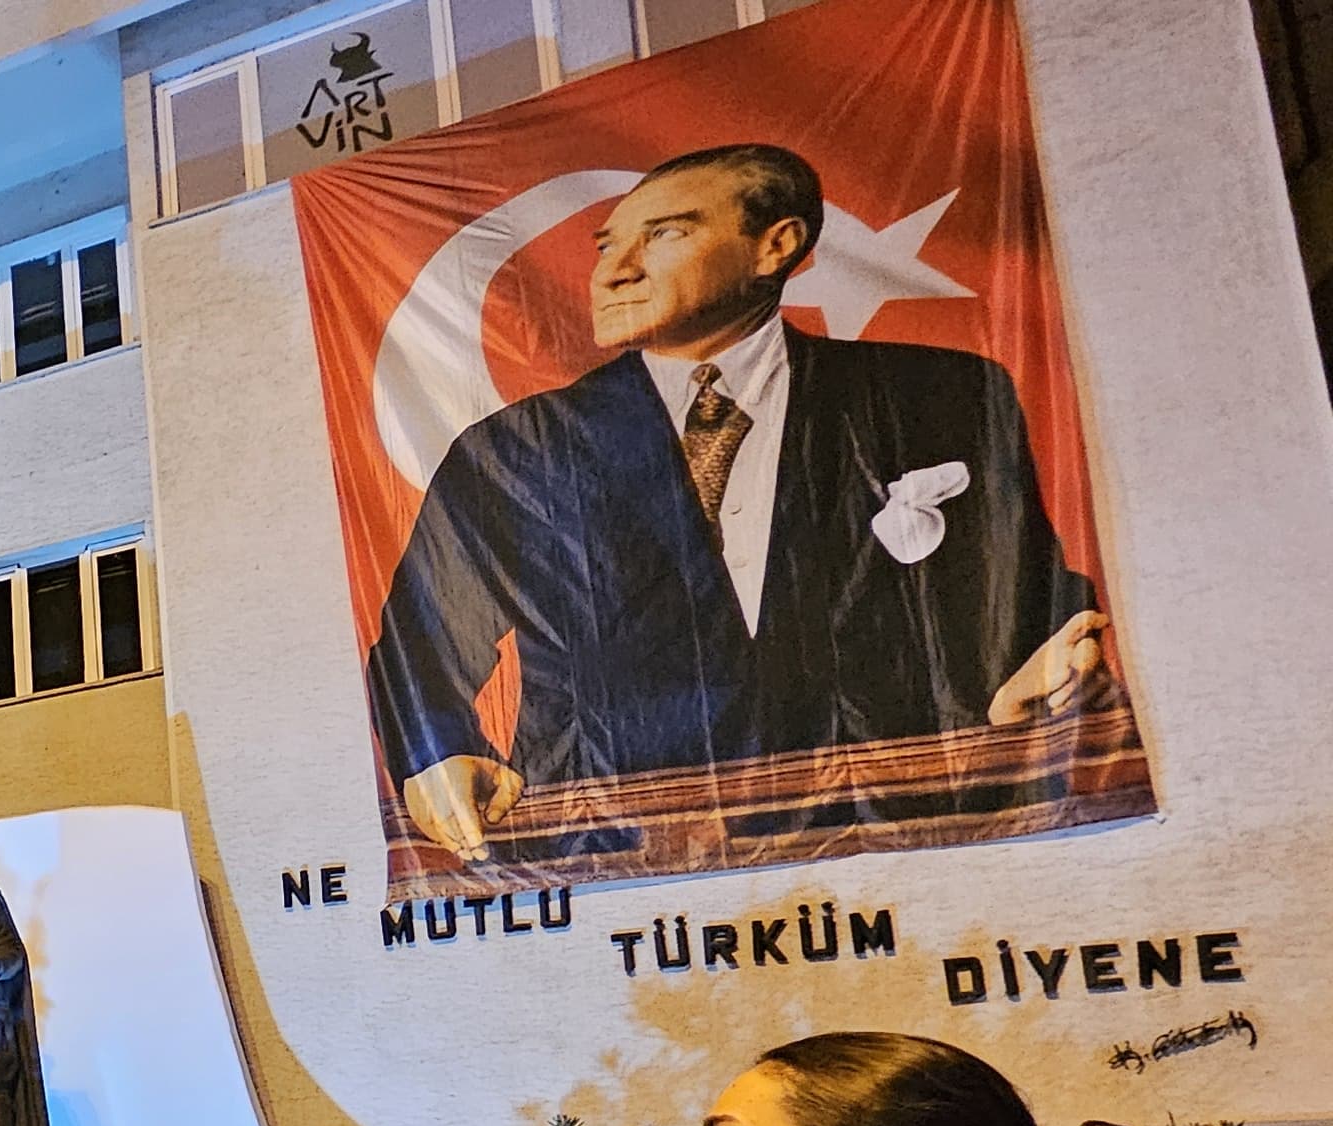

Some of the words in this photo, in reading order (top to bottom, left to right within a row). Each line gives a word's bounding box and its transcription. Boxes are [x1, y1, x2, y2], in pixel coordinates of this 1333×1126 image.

[282, 866, 348, 909] NE
[380, 886, 572, 947] MUTLU
[610, 901, 896, 976] TÜRKÜM
[942, 932, 1245, 1006] DİYENE
